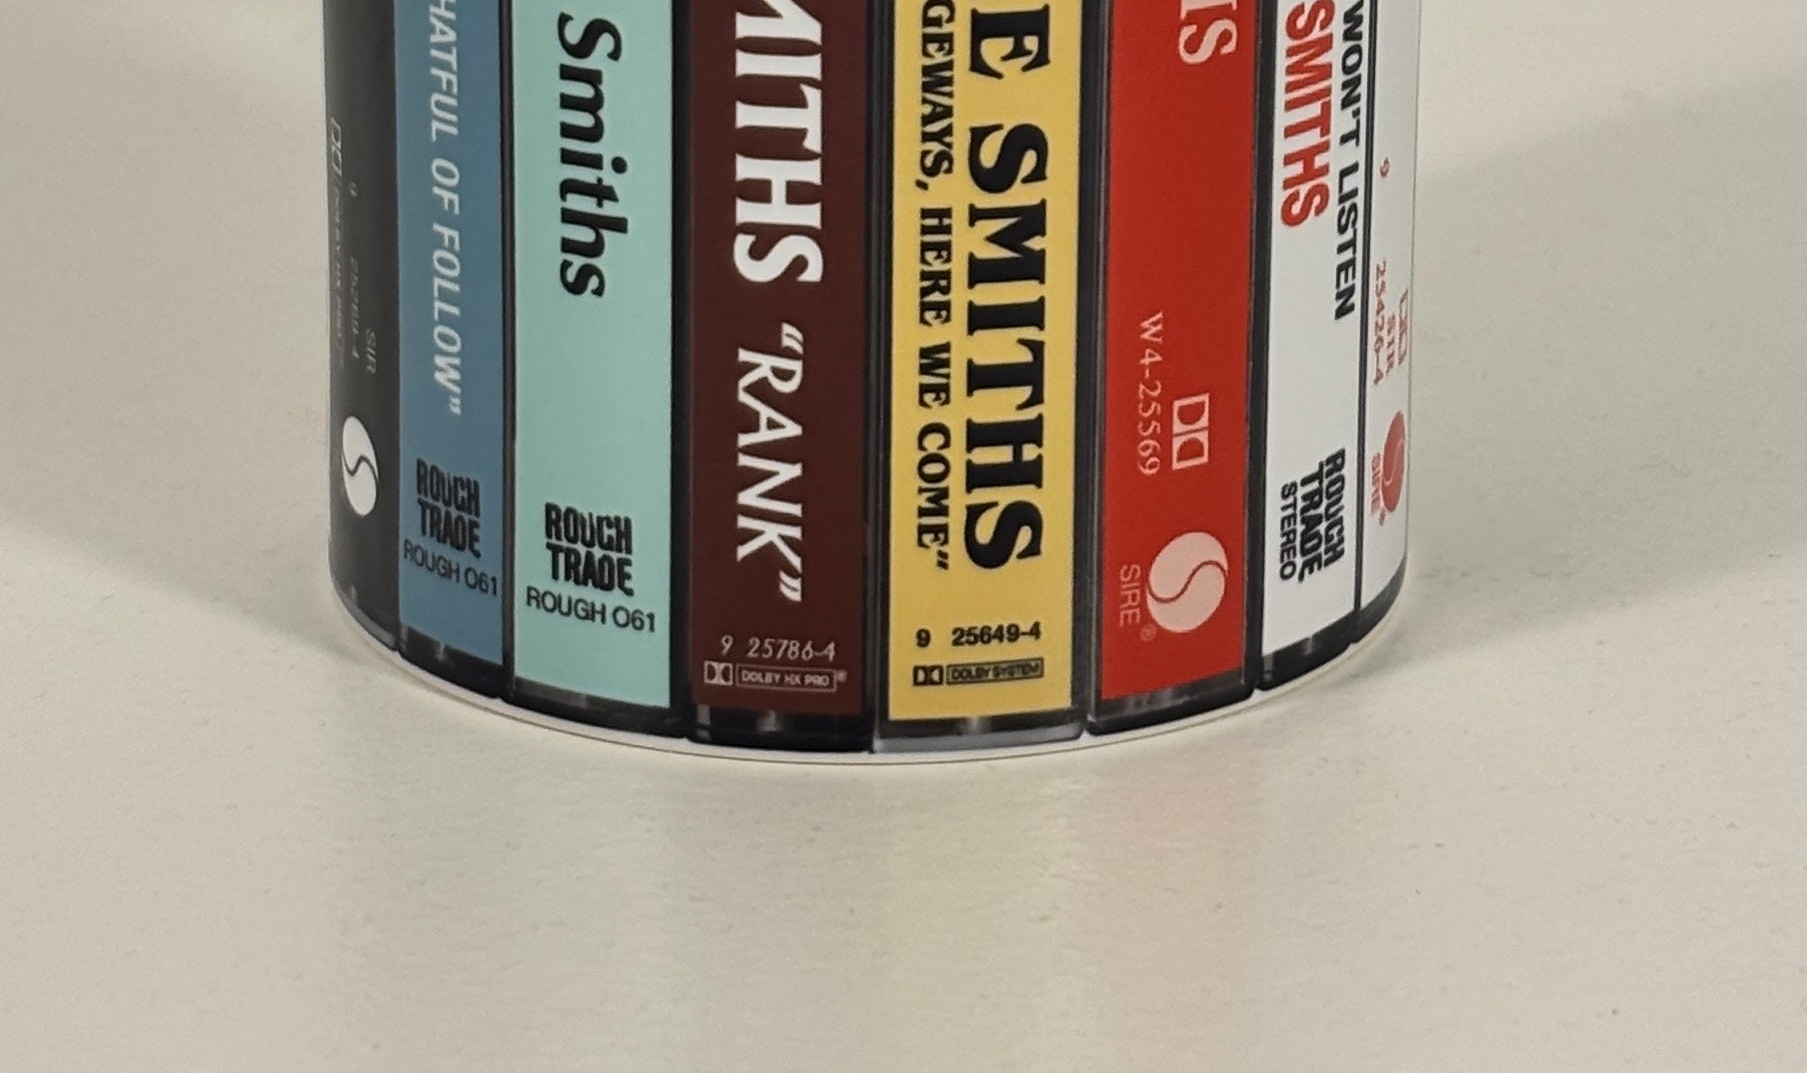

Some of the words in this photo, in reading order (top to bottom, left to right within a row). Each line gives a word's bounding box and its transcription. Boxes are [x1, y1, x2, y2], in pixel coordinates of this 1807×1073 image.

[431, 158, 460, 215] OF
[557, 12, 628, 299] Smiths
[919, 207, 953, 326] HERE
[1334, 160, 1360, 321] LISTEN
[918, 341, 952, 409] WE
[964, 123, 1048, 570] SMITHS
[416, 458, 480, 519] ROUGH
[736, 322, 804, 602] "RANK"
[417, 499, 481, 559] TRADE
[545, 502, 633, 555] ROUGH
[1280, 480, 1298, 581] STEREO
[1298, 460, 1325, 584] TRADE
[1323, 447, 1346, 569] ROUGH
[404, 538, 460, 580] ROUGH
[546, 541, 633, 596] TRADE
[527, 586, 606, 624] ROUGH
[1119, 563, 1142, 627] SIRE
[721, 635, 733, 656] 9
[747, 638, 836, 662] 25786-4
[916, 628, 931, 647] 9
[951, 621, 1041, 646] 25649-4
[741, 670, 780, 684] DOLBY
[805, 674, 830, 687] PRO
